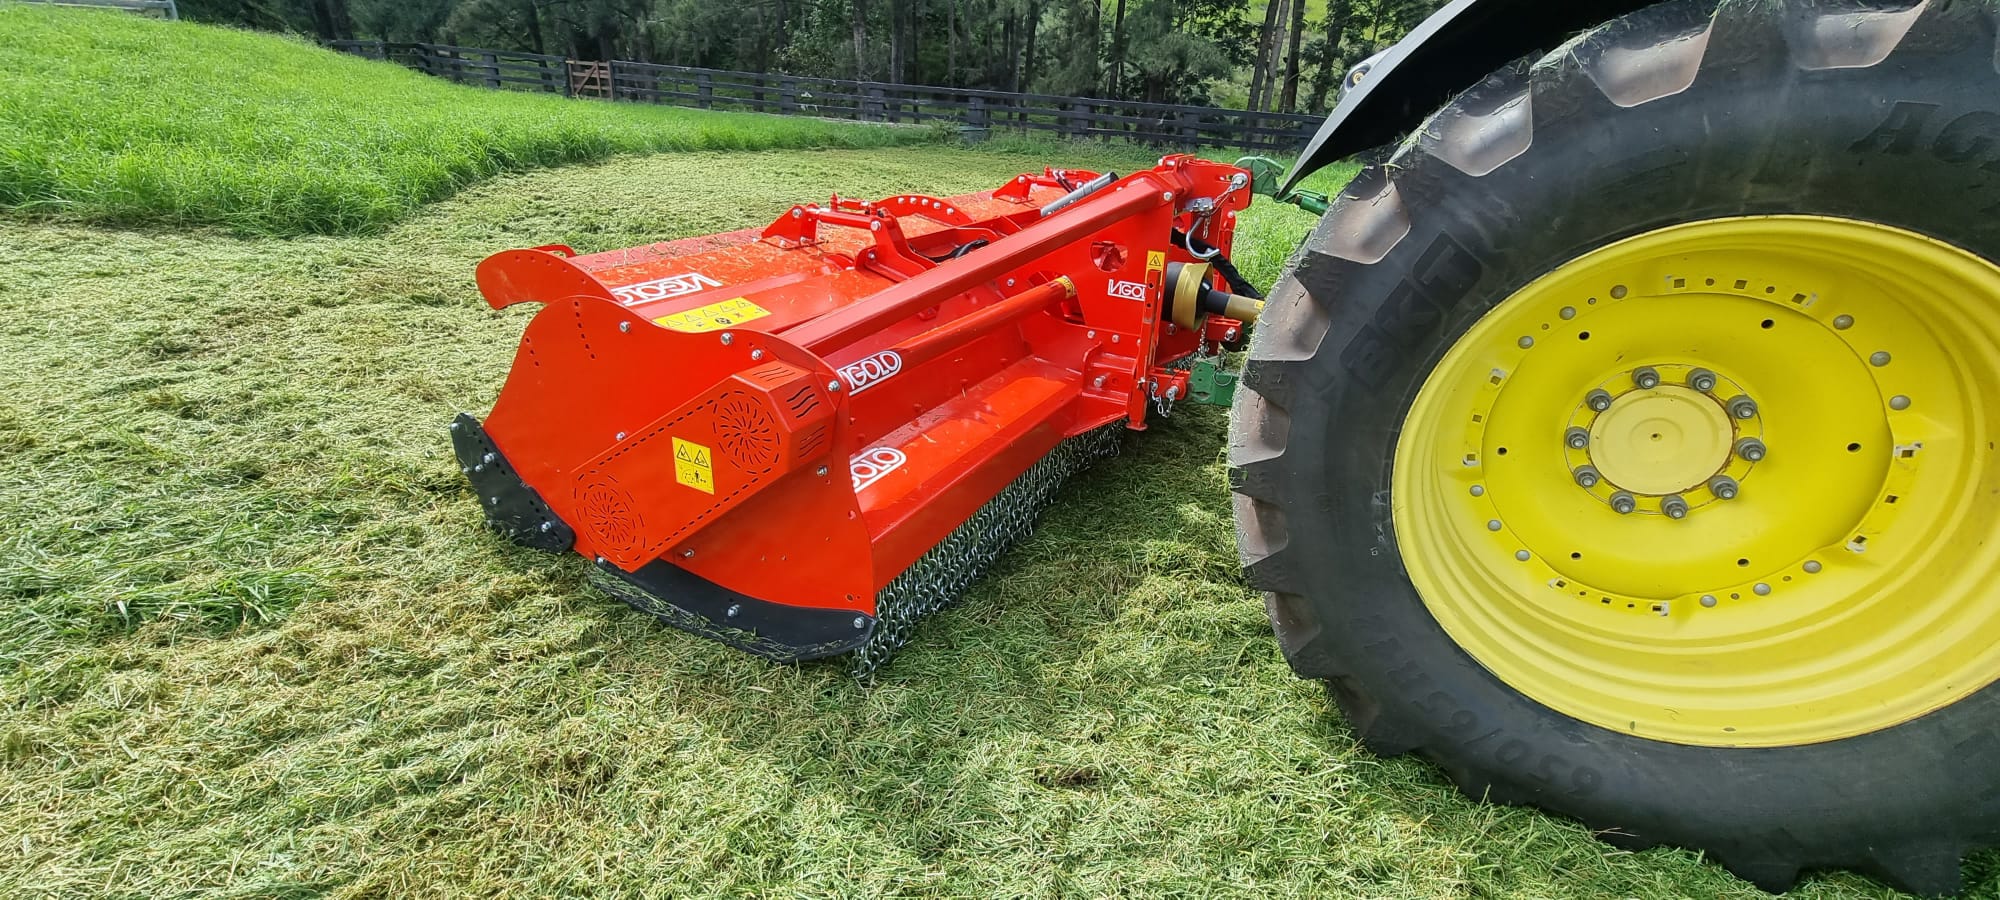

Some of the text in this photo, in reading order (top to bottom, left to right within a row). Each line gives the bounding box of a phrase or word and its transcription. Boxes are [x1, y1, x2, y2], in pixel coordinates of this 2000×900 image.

[1107, 279, 1147, 301] VIGOL
[1340, 230, 1482, 392] BKT
[838, 351, 902, 395] IGOLO
